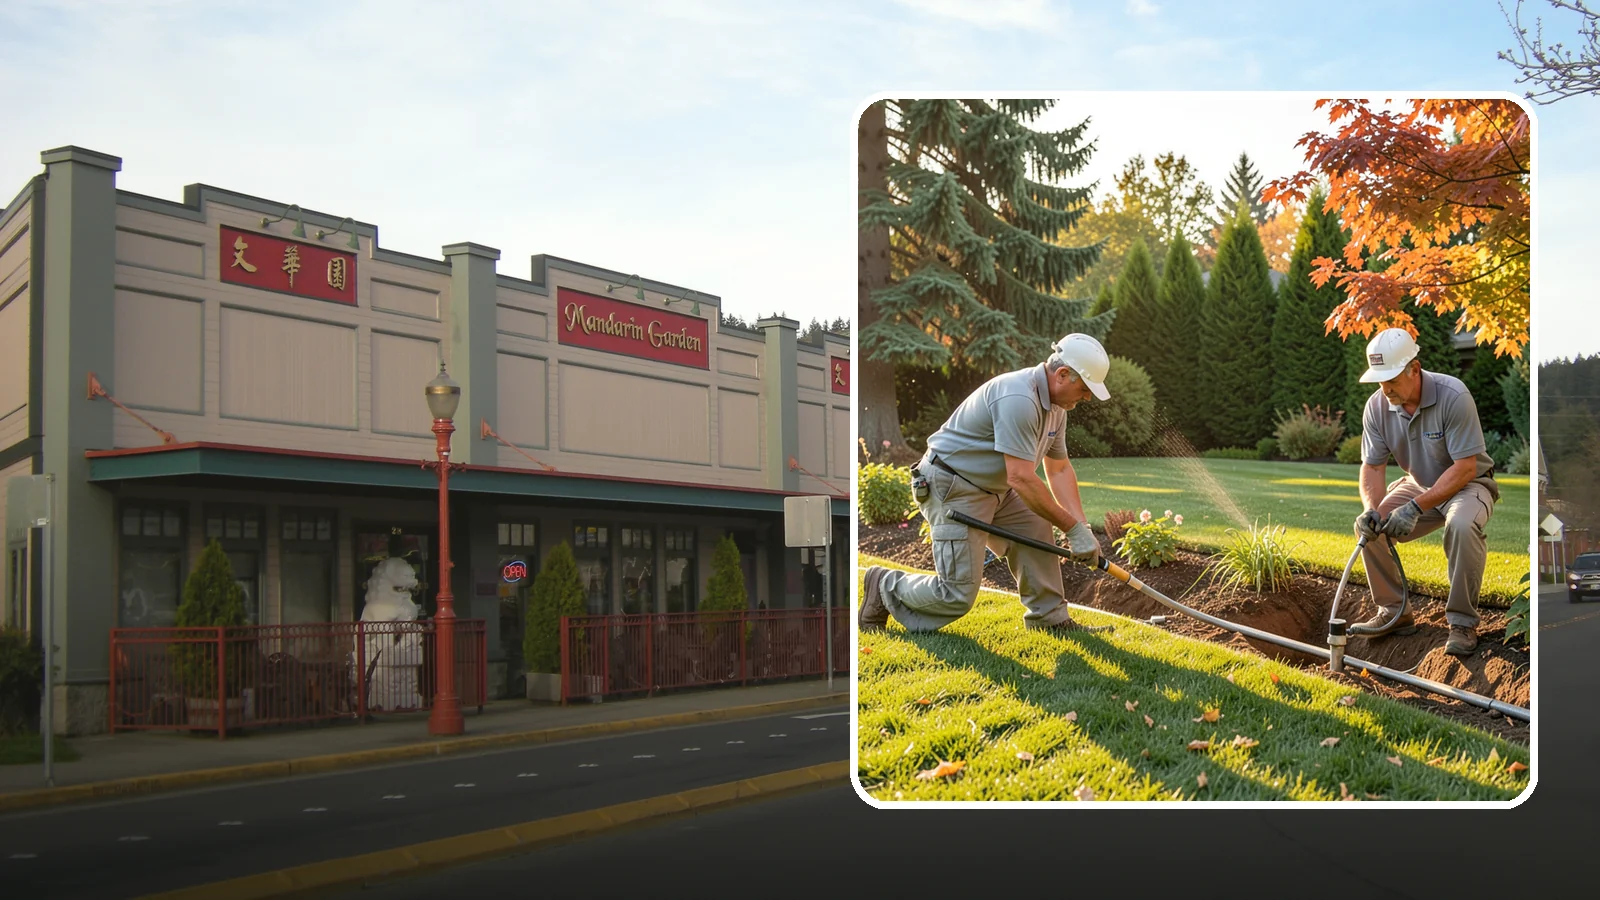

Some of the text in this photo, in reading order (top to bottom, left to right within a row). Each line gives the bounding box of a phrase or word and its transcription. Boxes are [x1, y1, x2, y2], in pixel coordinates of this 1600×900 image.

[230, 235, 346, 291] 文華園
[564, 302, 701, 352] Mandarin Garden
[503, 565, 526, 578] OPEN
